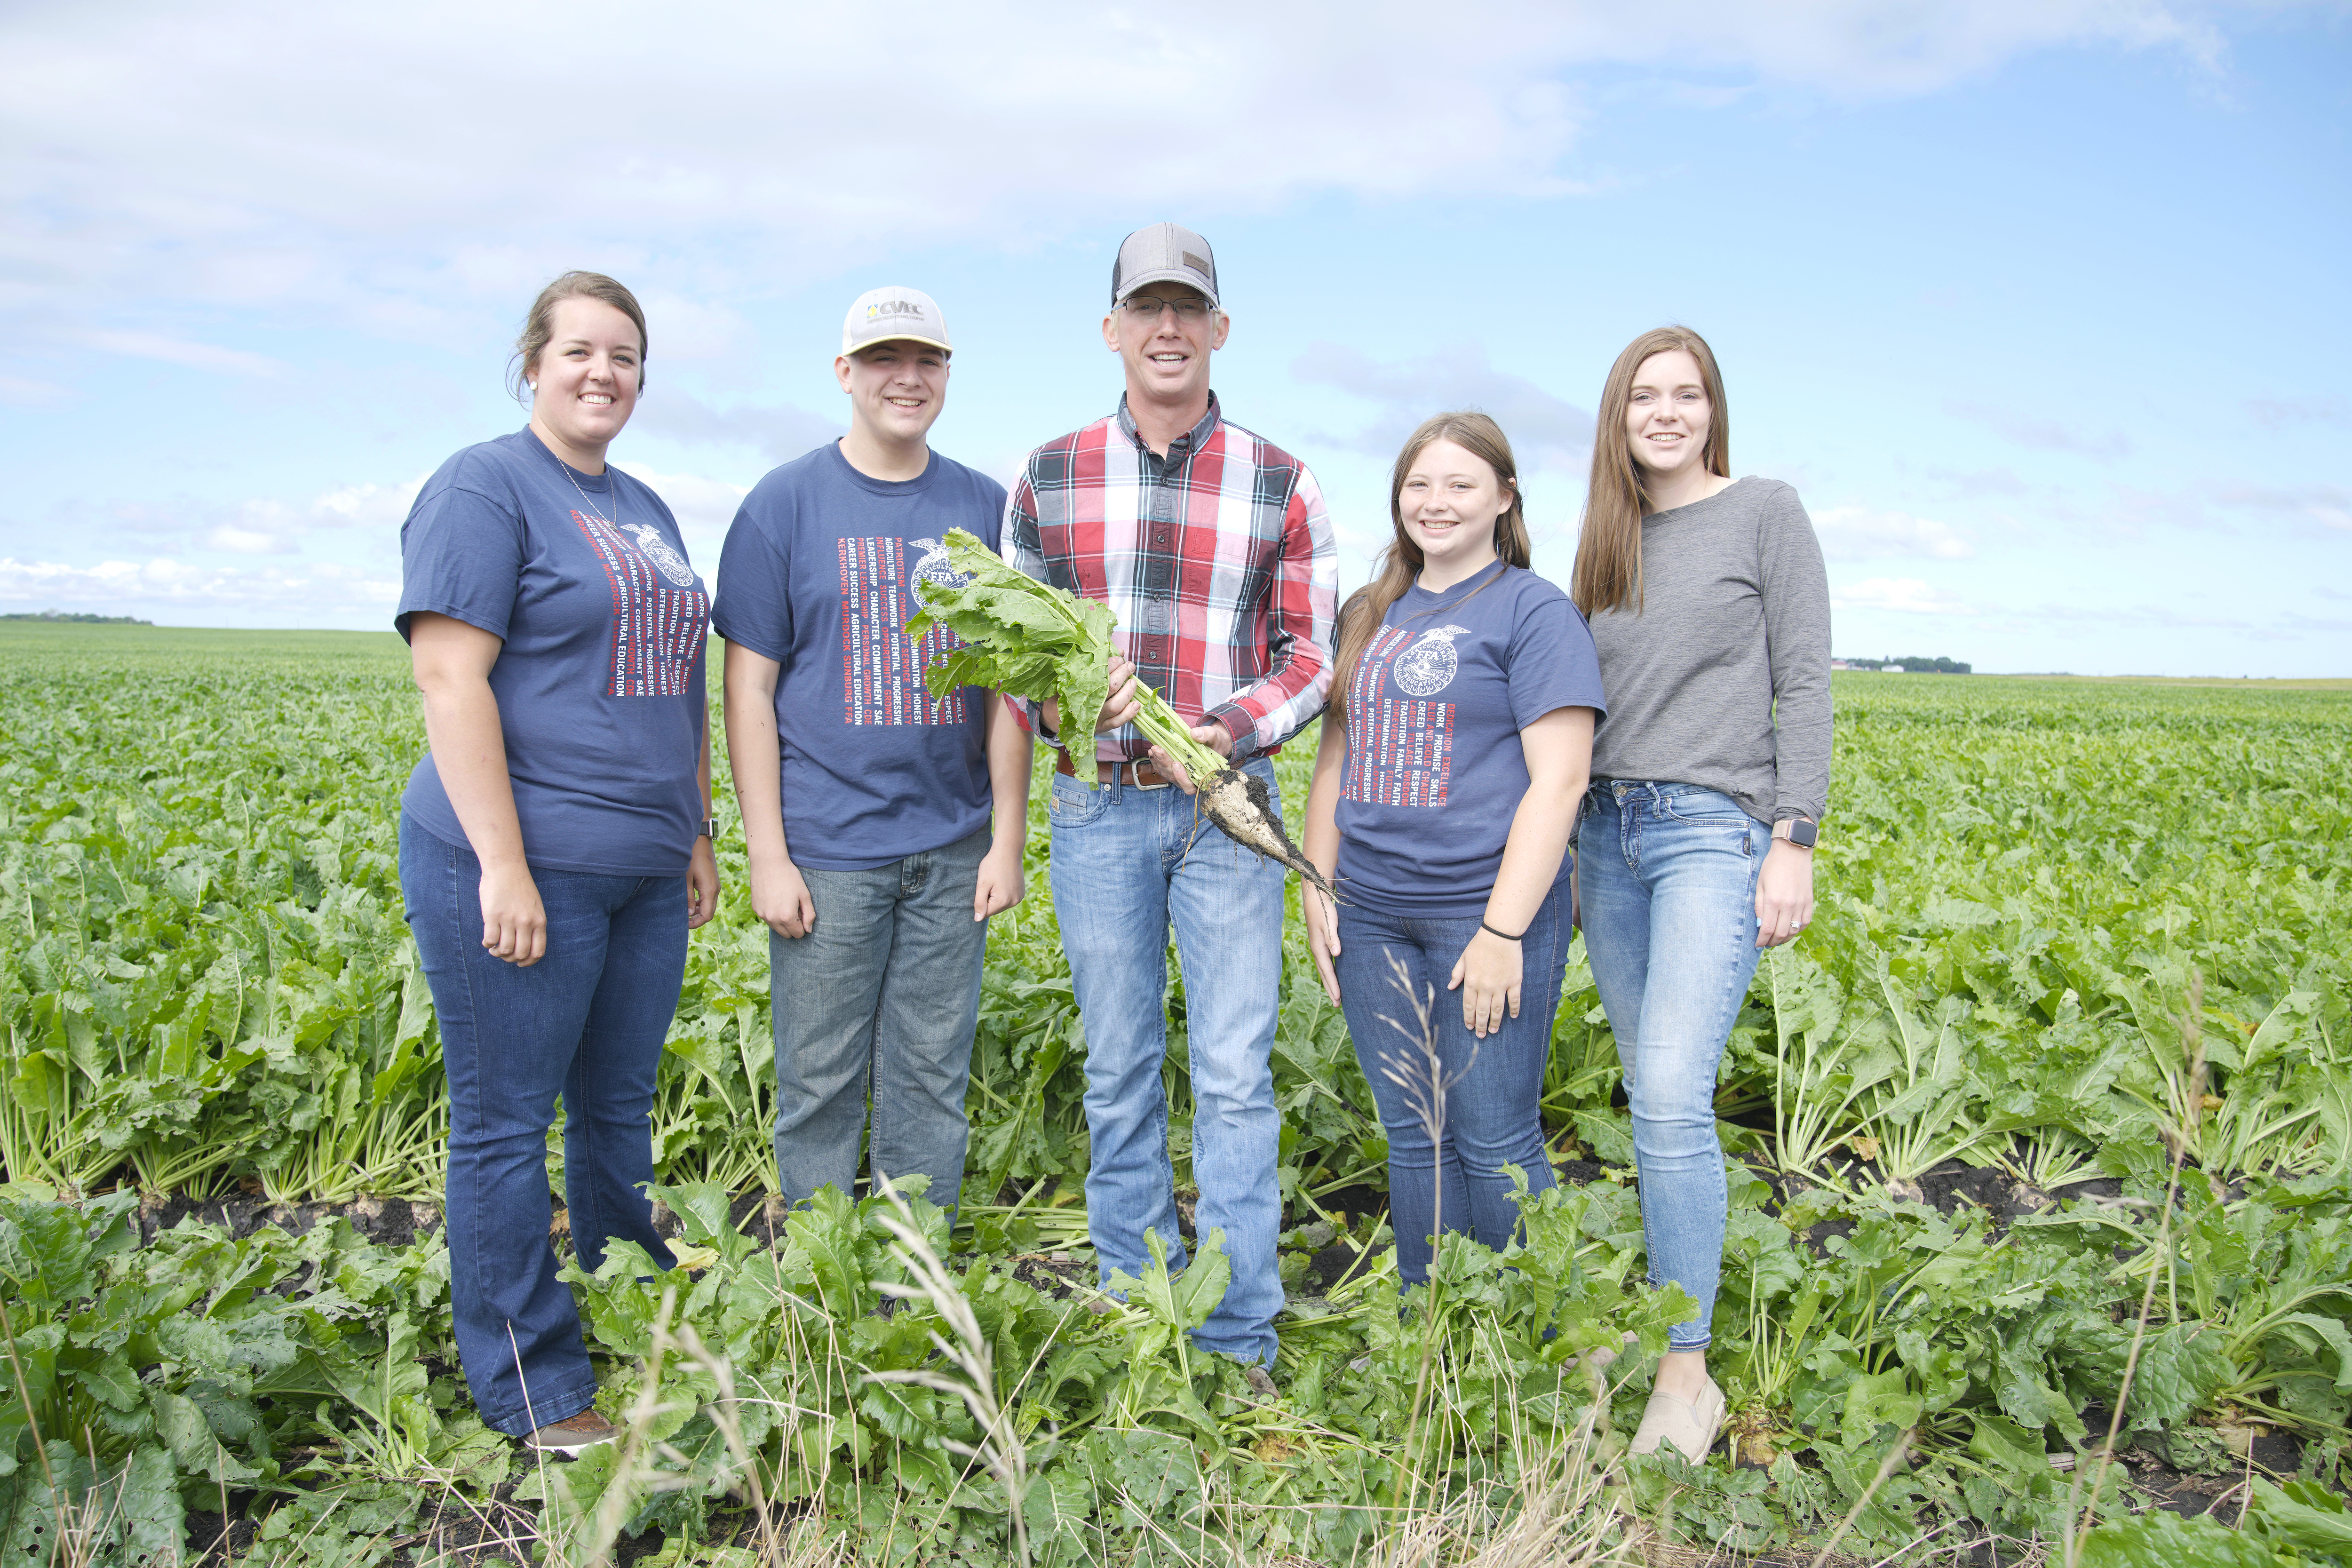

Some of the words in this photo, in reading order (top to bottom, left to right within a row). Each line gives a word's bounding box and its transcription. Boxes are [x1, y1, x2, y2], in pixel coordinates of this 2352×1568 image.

[880, 301, 924, 316] CVEC
[570, 510, 606, 559] KERKHOVEN
[579, 510, 600, 537] CAREER
[597, 538, 620, 571] SUCCESS
[606, 539, 630, 581] LEADERSHIP
[628, 550, 646, 585] SUCCESS
[634, 552, 652, 591] TEAMWORK
[838, 538, 849, 595] KERKHOVEN
[847, 538, 857, 568] CAREER
[857, 537, 866, 569] PREMIER
[866, 537, 877, 586] LEADERSHIP
[876, 537, 886, 580] INFLUENCE
[885, 537, 895, 581] AGRICULTURE
[895, 537, 905, 587] PATRIOTISM
[603, 564, 620, 615] MURDOCK
[625, 554, 640, 604] CHARACTER
[644, 559, 659, 611] COMMUNITY
[850, 571, 859, 608] SUCCESS
[923, 564, 960, 584] GRICULTURAL
[930, 572, 953, 581] FFA
[616, 575, 628, 643] AGRICULTURAL
[669, 590, 679, 634] TRADITION
[859, 572, 868, 619] LEADERSHIP
[880, 585, 888, 621] SUCCESS
[889, 585, 898, 628] TEAMWORK
[842, 601, 851, 652] MURDOCK
[870, 591, 880, 640] CHARACTER
[610, 620, 619, 672] SUNBURG
[627, 636, 636, 674] GROWTH
[672, 622, 683, 654] TILLAGE
[677, 622, 691, 654] BELIEVE
[684, 633, 693, 655] GOLD
[687, 624, 702, 660] PROMISE
[851, 613, 861, 676] AGRICULTURAL
[862, 625, 870, 667] PERSONAL
[882, 627, 891, 685] OPPORTUNITY
[891, 633, 900, 672] POTENTIAL
[1364, 624, 1392, 662] LEADERSHIP
[1372, 629, 1400, 656] INFLUENCE
[1379, 630, 1407, 657] AGRICULTURE
[1384, 632, 1416, 663] PATRIOTISM
[1416, 650, 1438, 660] FFA
[616, 646, 627, 696] EDUCATION
[843, 655, 852, 702] SUNBURG
[872, 645, 882, 706] COMMITMENT
[901, 648, 910, 683] SERVICE
[1351, 650, 1365, 693] EADERSHIP
[1361, 661, 1375, 696] SUCCESS
[1368, 661, 1383, 702] TEAMWORK
[626, 679, 635, 696] CDE
[893, 676, 902, 725] PROGRESSIVE
[903, 688, 912, 724] LOYALTY
[1355, 667, 1366, 715] CHARACTER
[1376, 668, 1388, 721] COMMUNITY
[913, 693, 922, 725] HONEST
[1390, 700, 1400, 740] FOREVER
[1398, 700, 1408, 744] TRADITION
[1408, 700, 1417, 727] LABOR
[1417, 701, 1426, 728] CREED
[1427, 702, 1436, 722] BLUE
[1436, 703, 1446, 728] WORK
[1443, 704, 1455, 751] DEDICATION
[1380, 699, 1391, 765] DETERMINATION
[1405, 732, 1414, 765] TILLAGE
[1414, 732, 1423, 765] BELIEVE
[1425, 724, 1434, 741] AND
[1388, 743, 1397, 765] BLUE
[1395, 749, 1405, 779] FAMILY
[1423, 744, 1433, 766] GOLD
[1432, 734, 1443, 772] PROMISE
[1363, 752, 1372, 803] PROGRESSIVE
[1383, 770, 1393, 804] FUTURE
[1392, 782, 1401, 805] FAITH
[1401, 770, 1411, 806] WISDOM
[1409, 770, 1421, 807] RESPECT
[1419, 771, 1430, 807] CHARITY
[1429, 779, 1439, 807] SKILLS
[1438, 757, 1451, 807] EXCELLENCE
